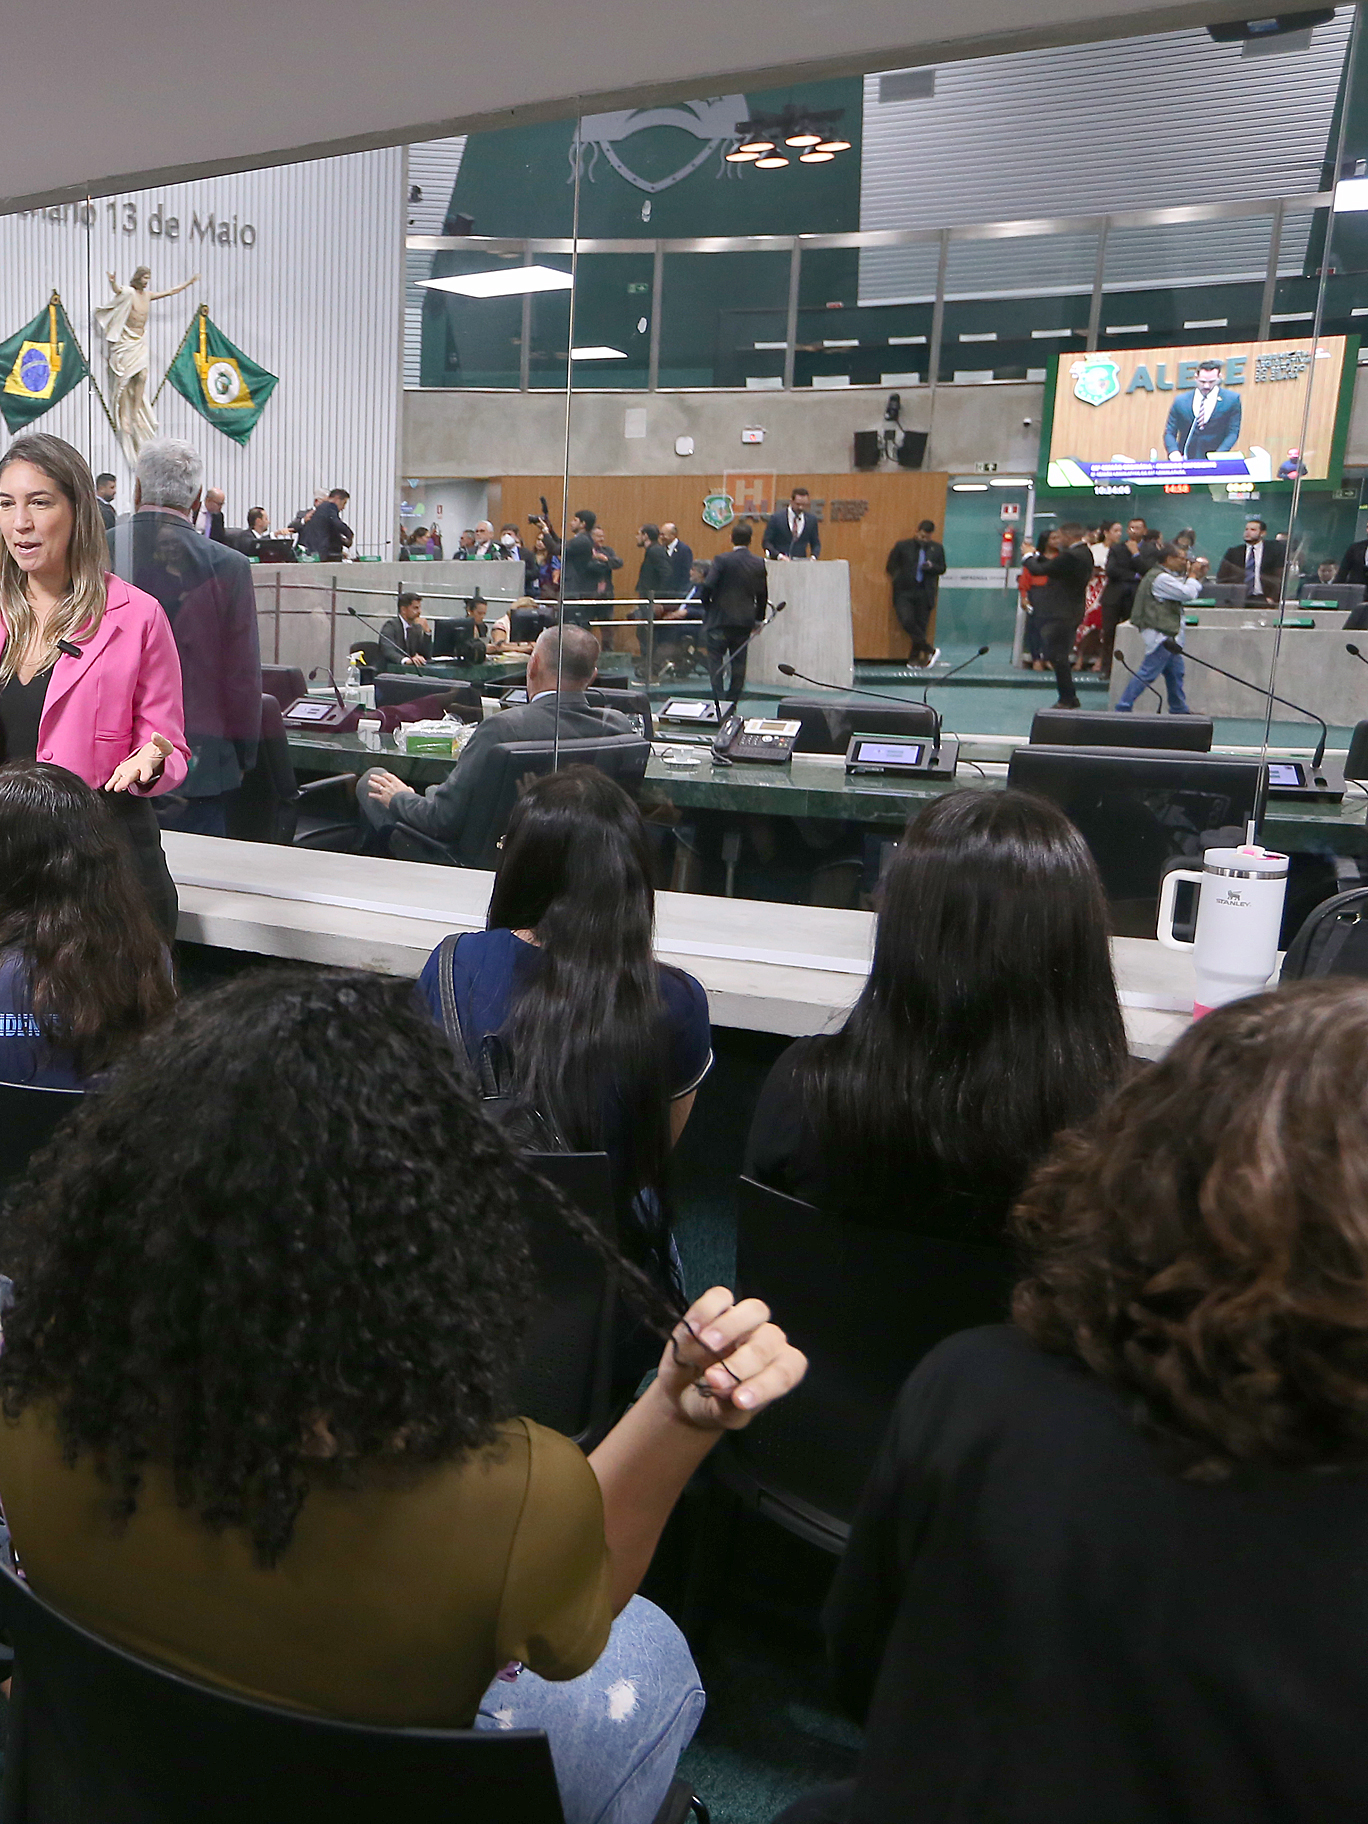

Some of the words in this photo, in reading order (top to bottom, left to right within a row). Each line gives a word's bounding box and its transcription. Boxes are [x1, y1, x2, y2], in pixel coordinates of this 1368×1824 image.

[106, 201, 138, 236] 13
[148, 203, 180, 241] de
[189, 210, 257, 249] Maio
[1126, 354, 1248, 394] ALEE
[1215, 898, 1251, 907] STANLEY
